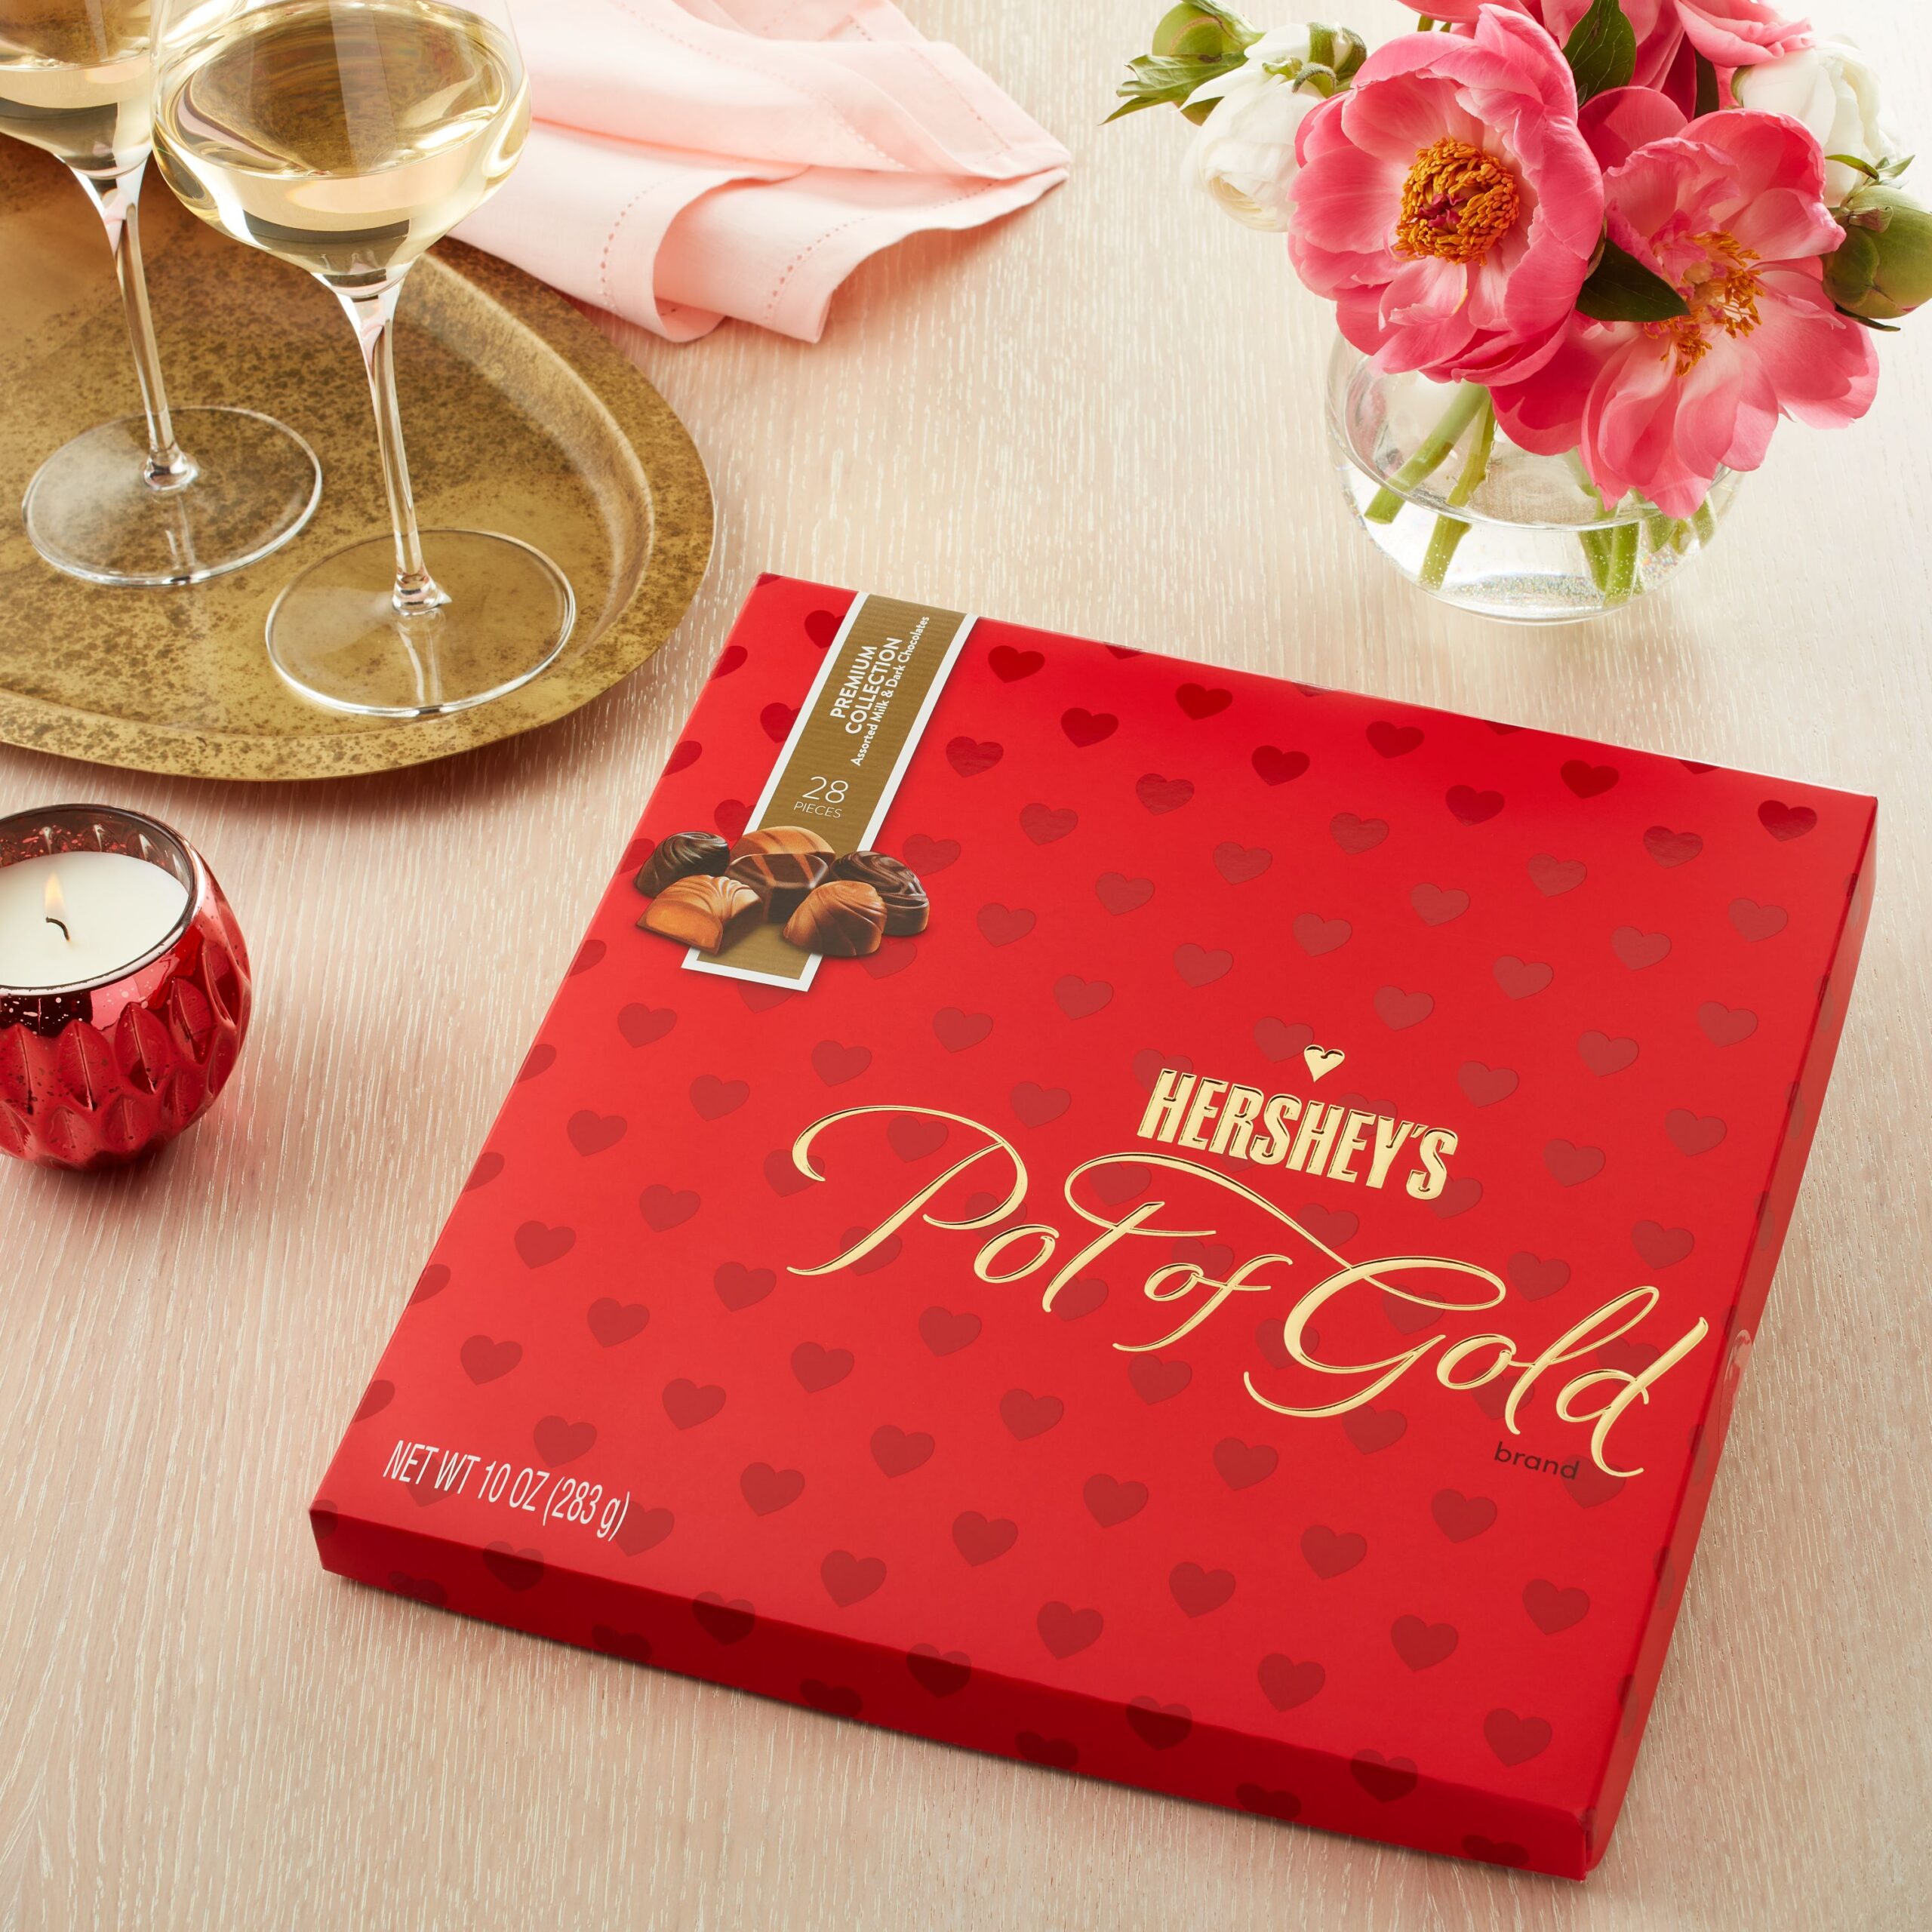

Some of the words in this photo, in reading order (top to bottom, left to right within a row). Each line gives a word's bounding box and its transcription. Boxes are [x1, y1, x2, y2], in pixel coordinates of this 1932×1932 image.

[897, 615, 930, 663] Chocolates
[829, 645, 878, 718] PREMIUM
[845, 637, 903, 734] COLLECTION
[881, 689, 894, 698] &
[885, 663, 906, 688] Dark
[869, 700, 889, 723] Milk
[851, 723, 878, 767] Assorted
[793, 801, 842, 819] PIECES
[801, 776, 849, 804] 28
[1137, 1069, 1458, 1200] HERSHEY'S
[786, 1105, 1166, 1313] Pot
[1112, 1254, 1293, 1352] of
[1244, 1254, 1709, 1478] Gold
[1494, 1441, 1580, 1480] brand
[383, 1440, 439, 1484] NET
[434, 1450, 481, 1494] WT
[477, 1460, 512, 1503] 10
[509, 1467, 550, 1512] OZ
[543, 1476, 603, 1526] (283
[596, 1491, 630, 1542] g)
